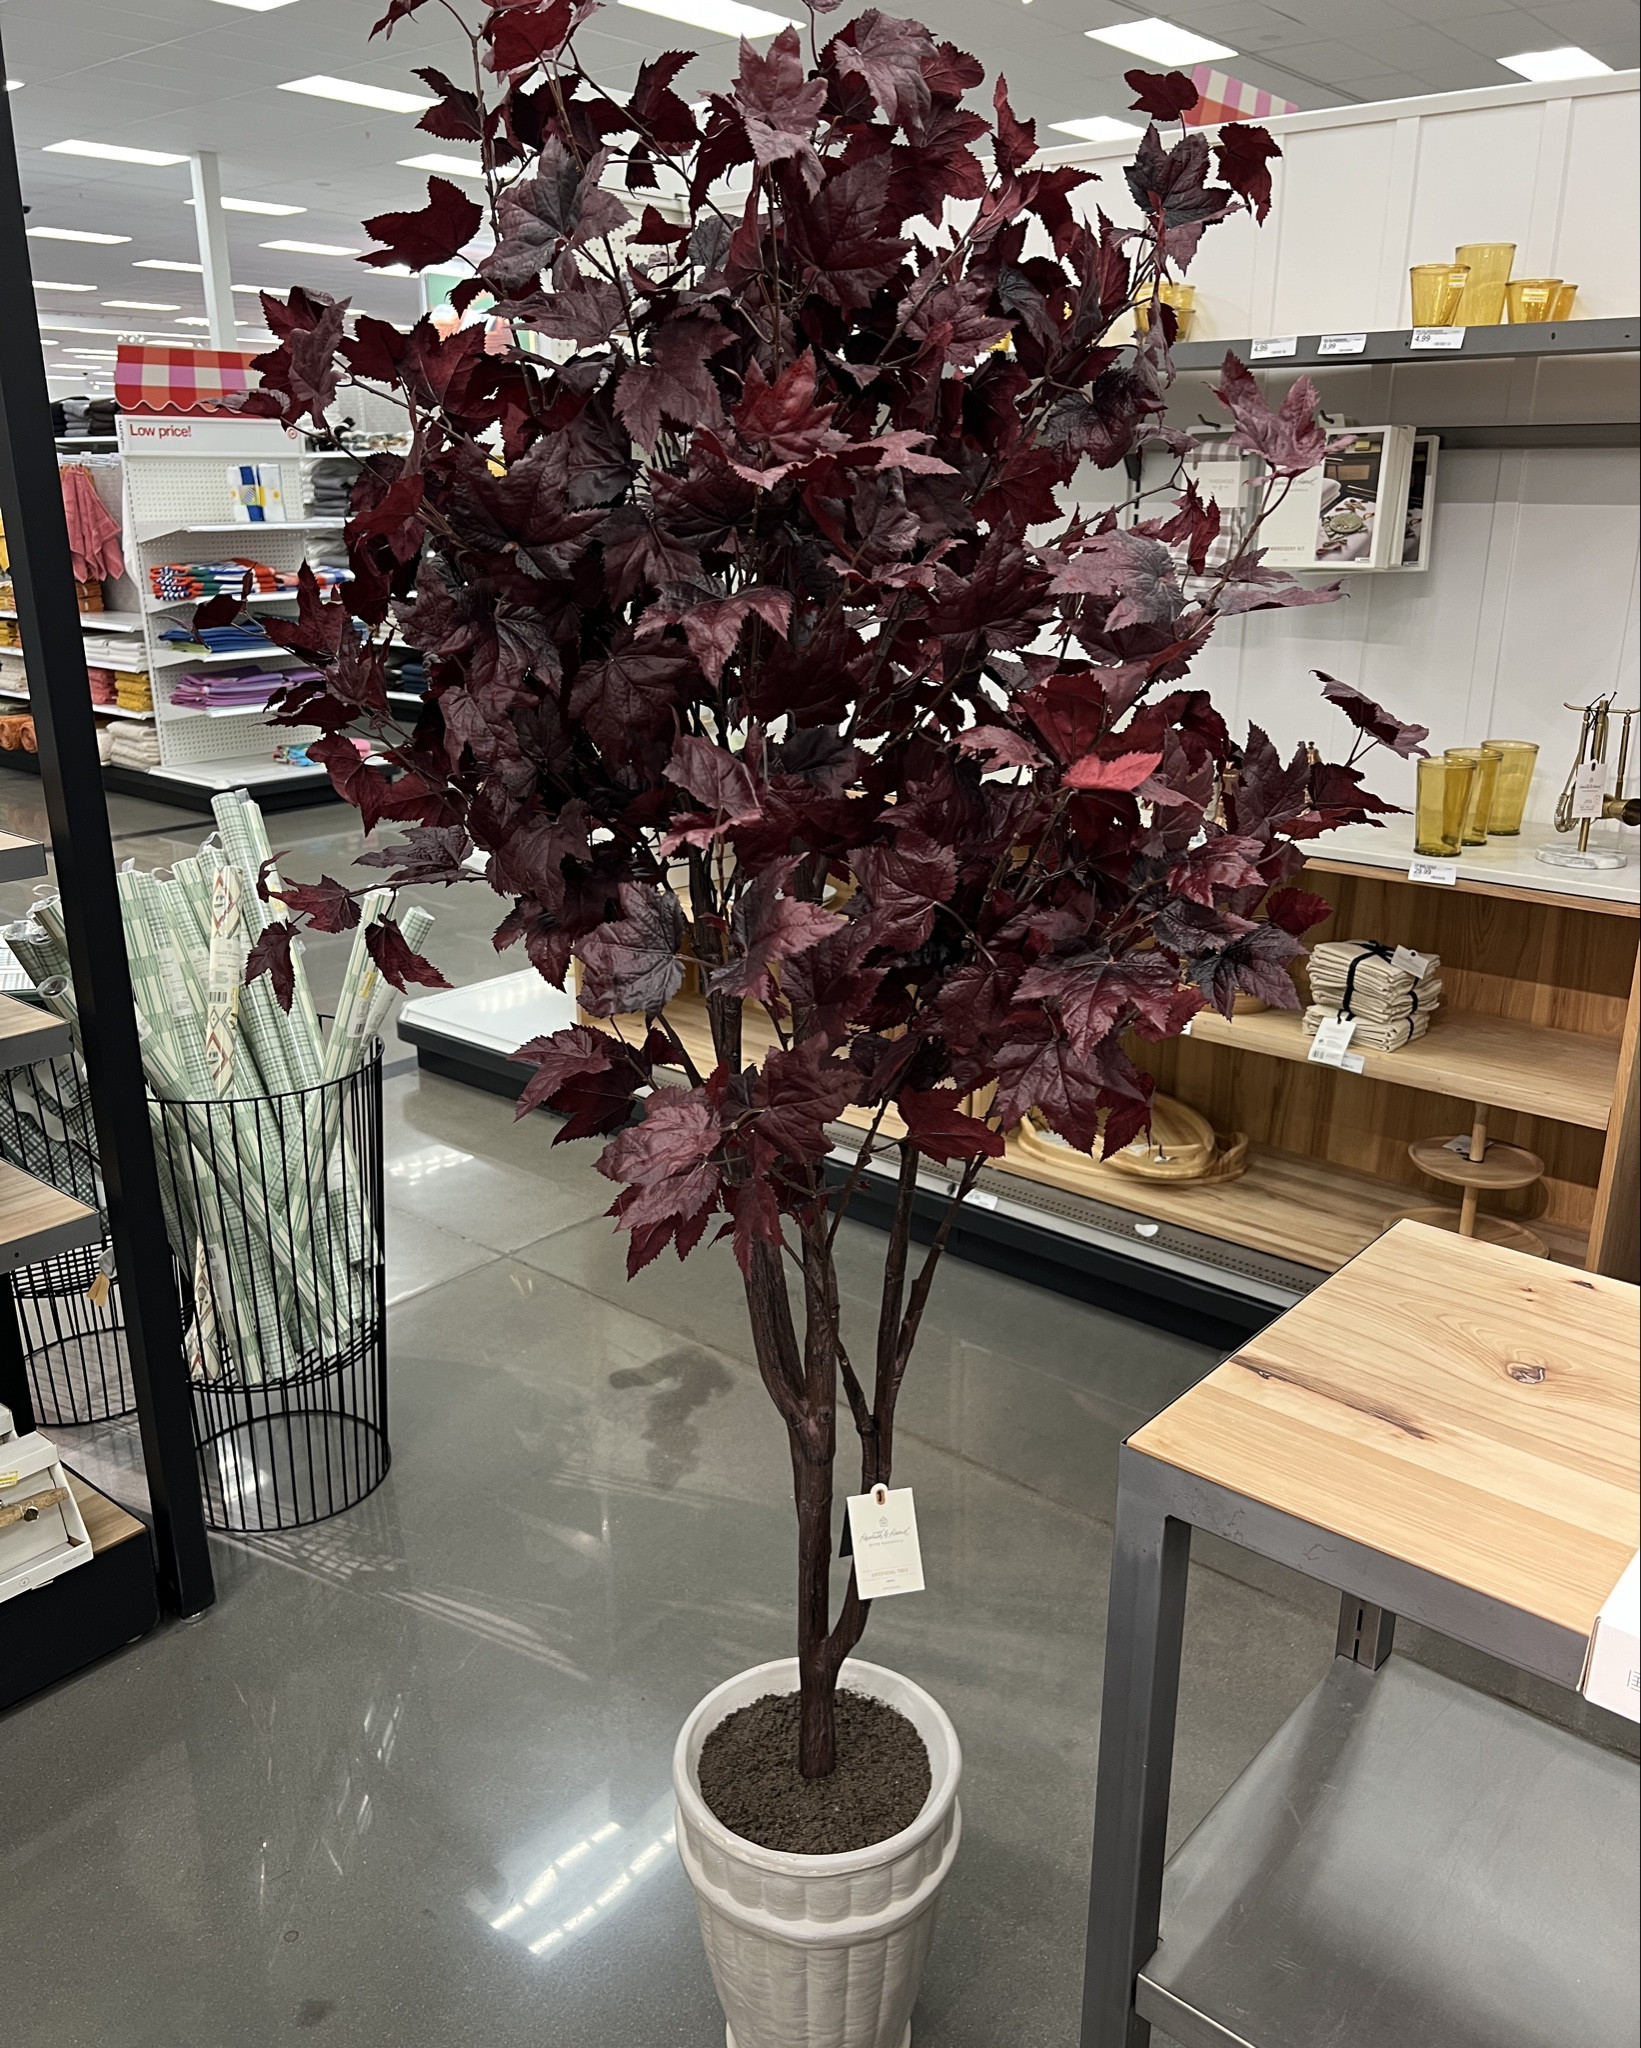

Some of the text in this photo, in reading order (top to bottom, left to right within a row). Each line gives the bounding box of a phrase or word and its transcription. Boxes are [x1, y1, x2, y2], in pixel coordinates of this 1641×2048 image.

[1414, 335, 1431, 343] 4.99
[1254, 344, 1268, 353] 4.99
[130, 424, 192, 439] Low price!
